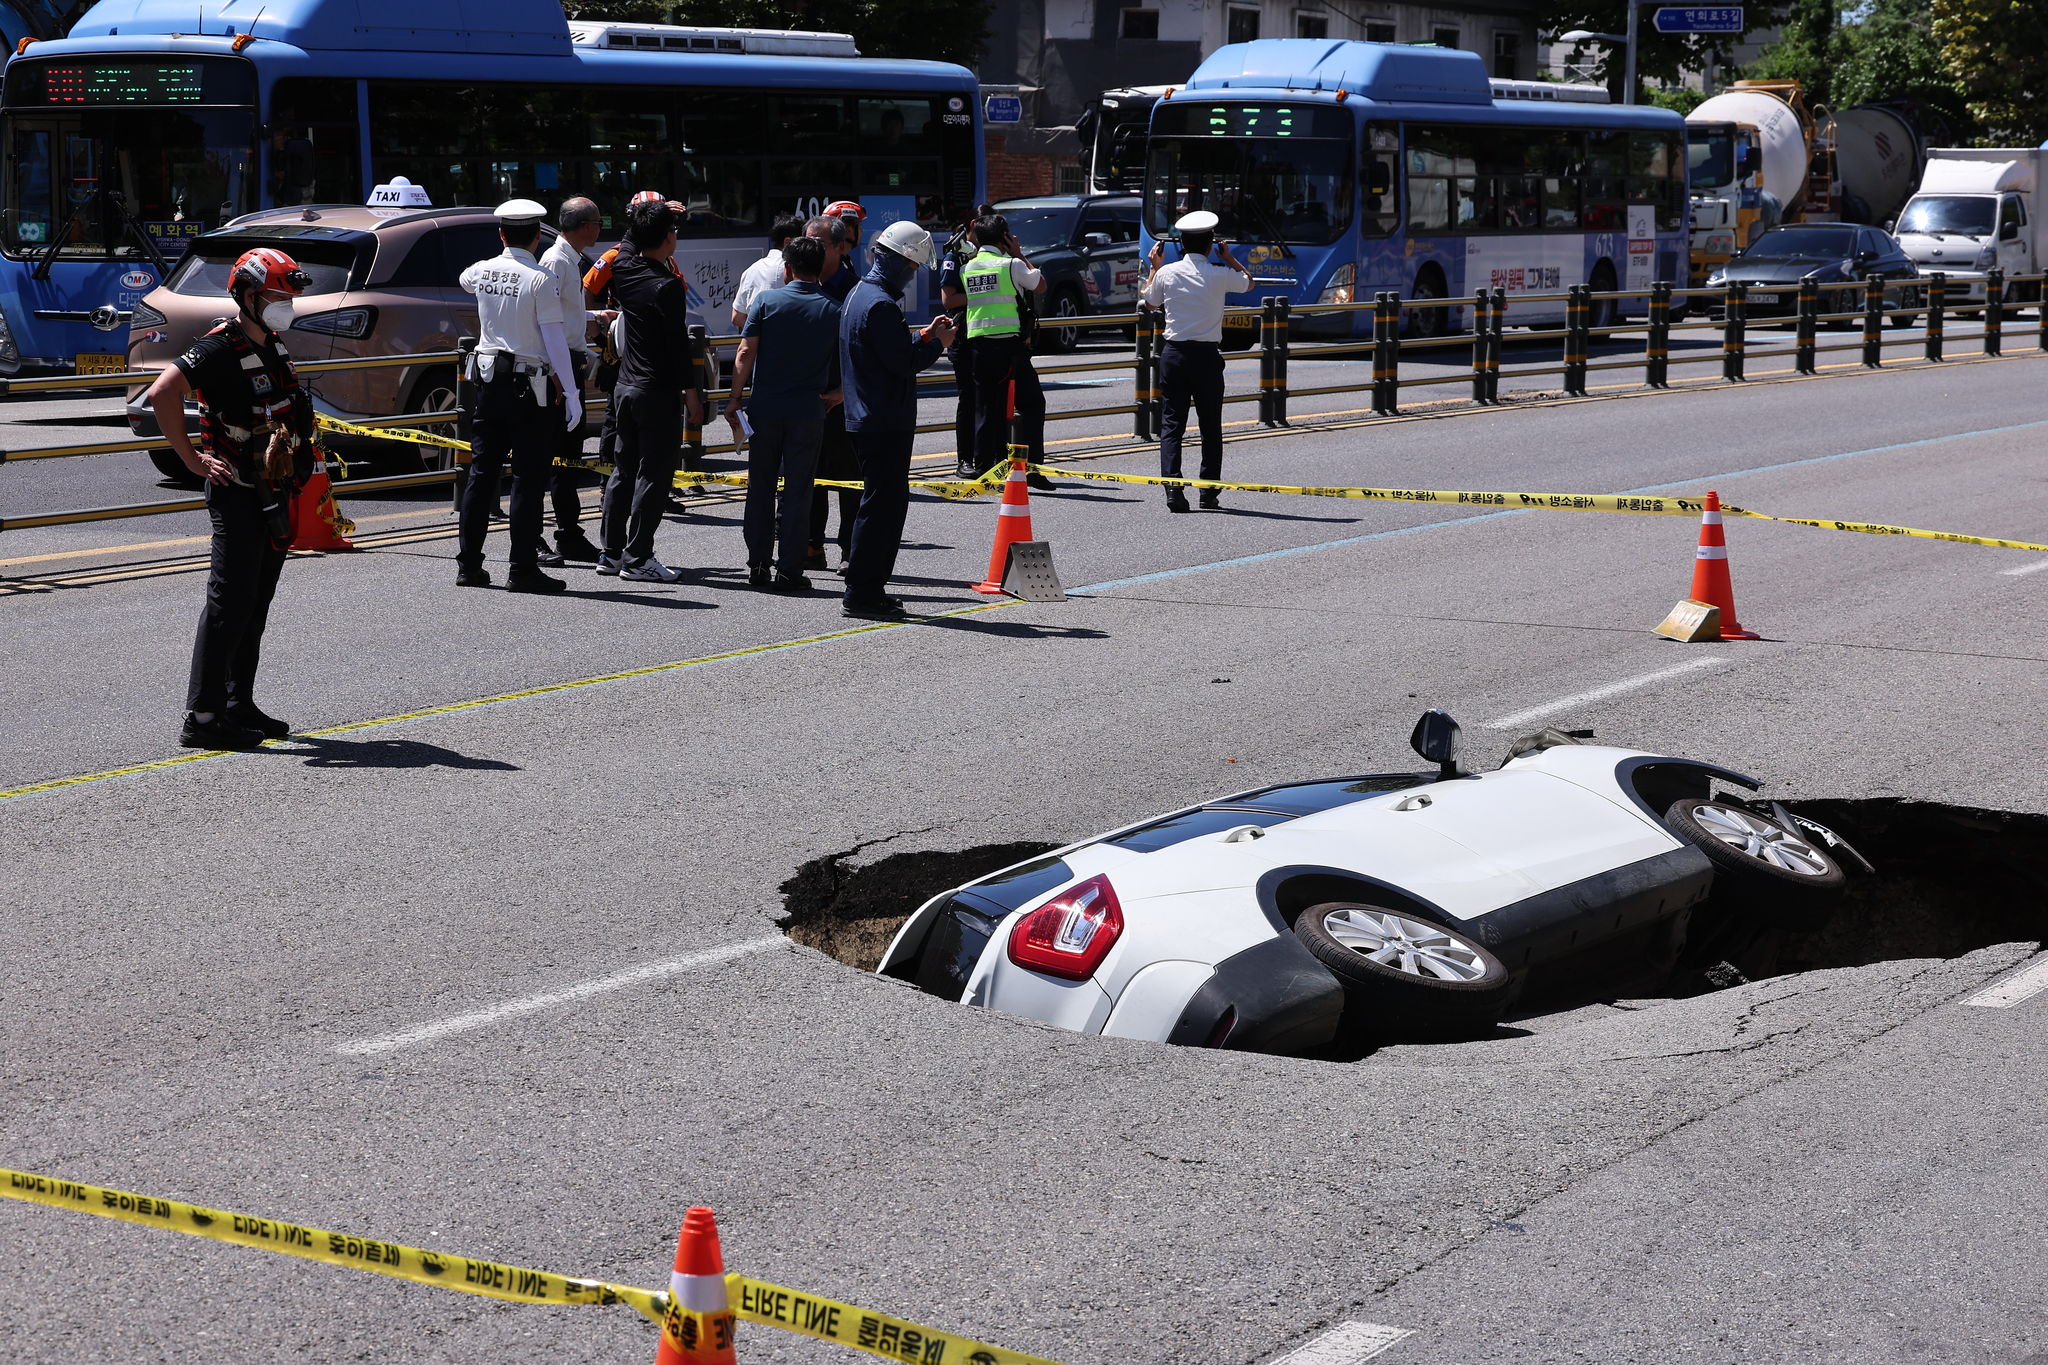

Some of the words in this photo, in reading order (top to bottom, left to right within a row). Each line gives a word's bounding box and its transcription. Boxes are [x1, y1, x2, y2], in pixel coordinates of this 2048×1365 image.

[376, 191, 401, 202] TAXI
[148, 223, 199, 237] 혜화역
[1595, 233, 1614, 257] 673
[1247, 264, 1296, 275] 천연가스버스
[127, 275, 147, 284] DMA
[481, 269, 521, 284] 교통경찰
[968, 274, 996, 286] 교통경찰
[1527, 267, 1544, 290] 그게
[478, 283, 520, 298] POLICE
[969, 284, 995, 293] POLICE
[118, 292, 147, 307] 다모
[1224, 316, 1251, 327] 1403
[87, 355, 101, 365] 서울
[101, 355, 113, 365] 74
[256, 386, 272, 394] KOREA
